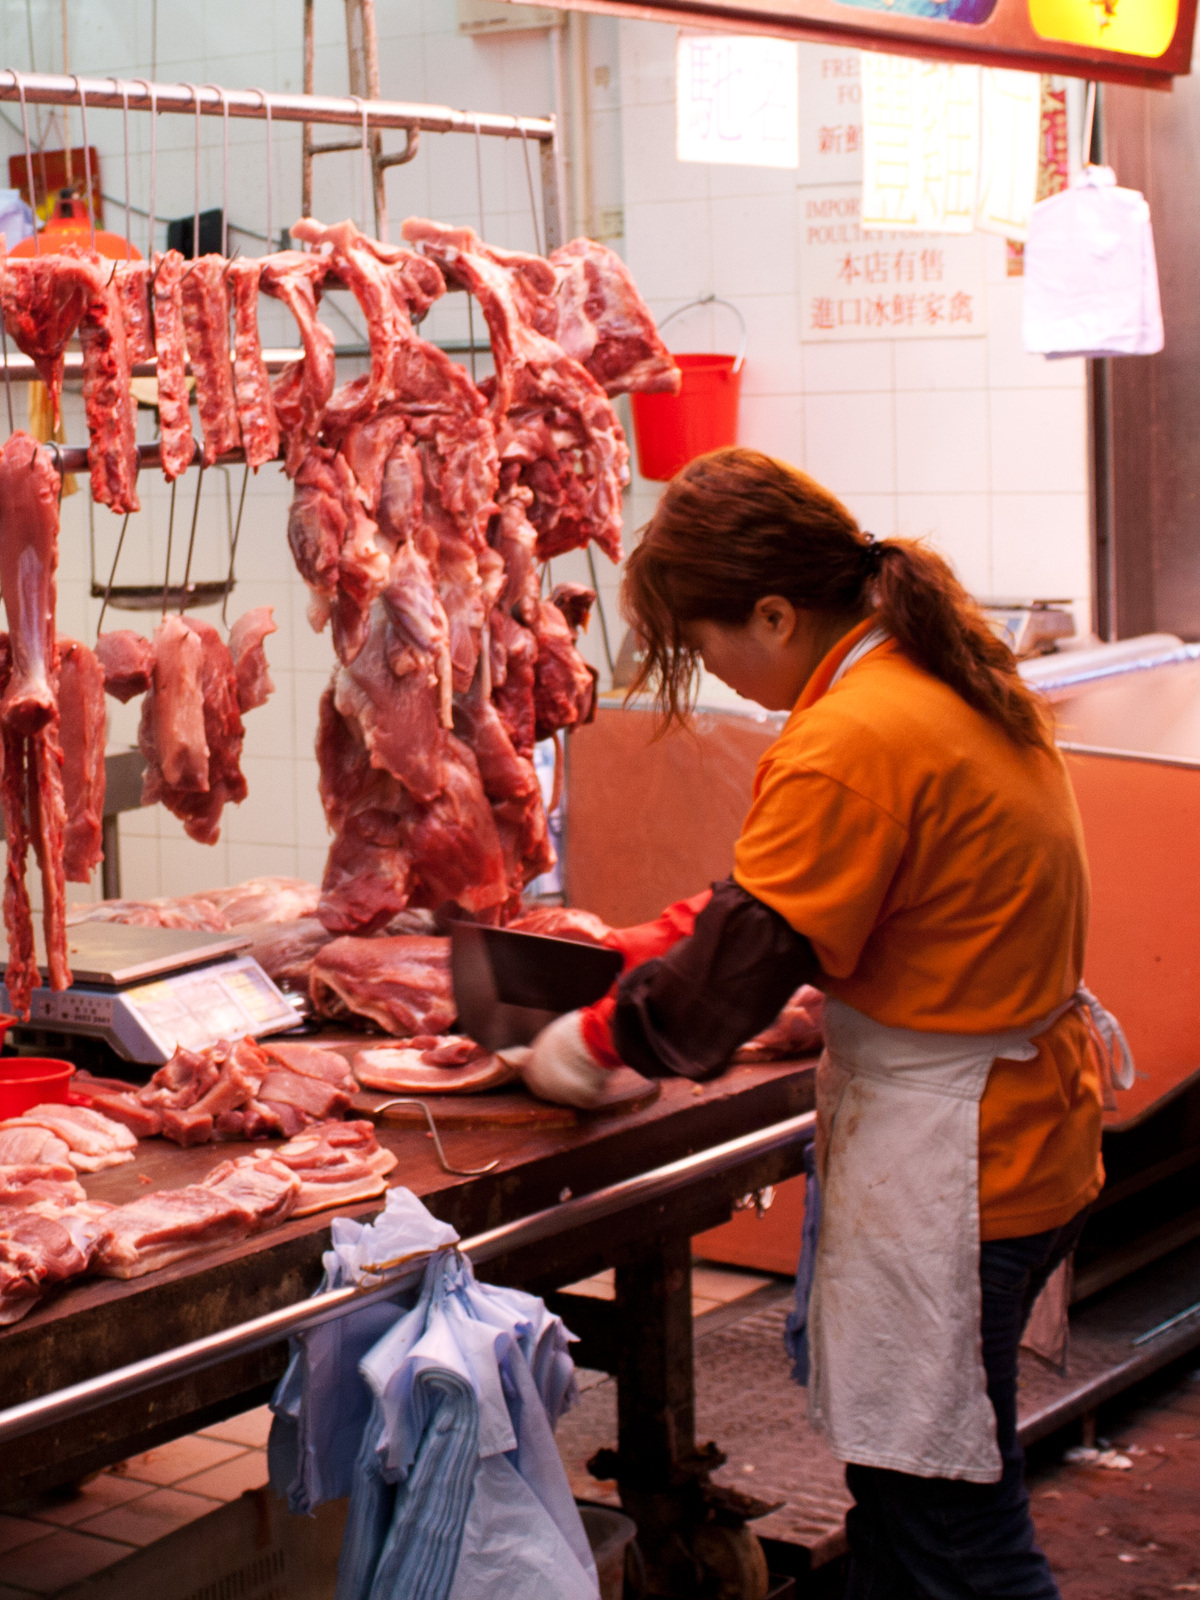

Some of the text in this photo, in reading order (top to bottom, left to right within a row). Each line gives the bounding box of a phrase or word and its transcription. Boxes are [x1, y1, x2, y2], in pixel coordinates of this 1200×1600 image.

[821, 56, 860, 78] FRE
[688, 41, 788, 142] 馳名
[805, 197, 860, 219] IMPOR
[837, 248, 943, 285] 本店有售
[810, 290, 973, 329] 進口冰鮮家禽
